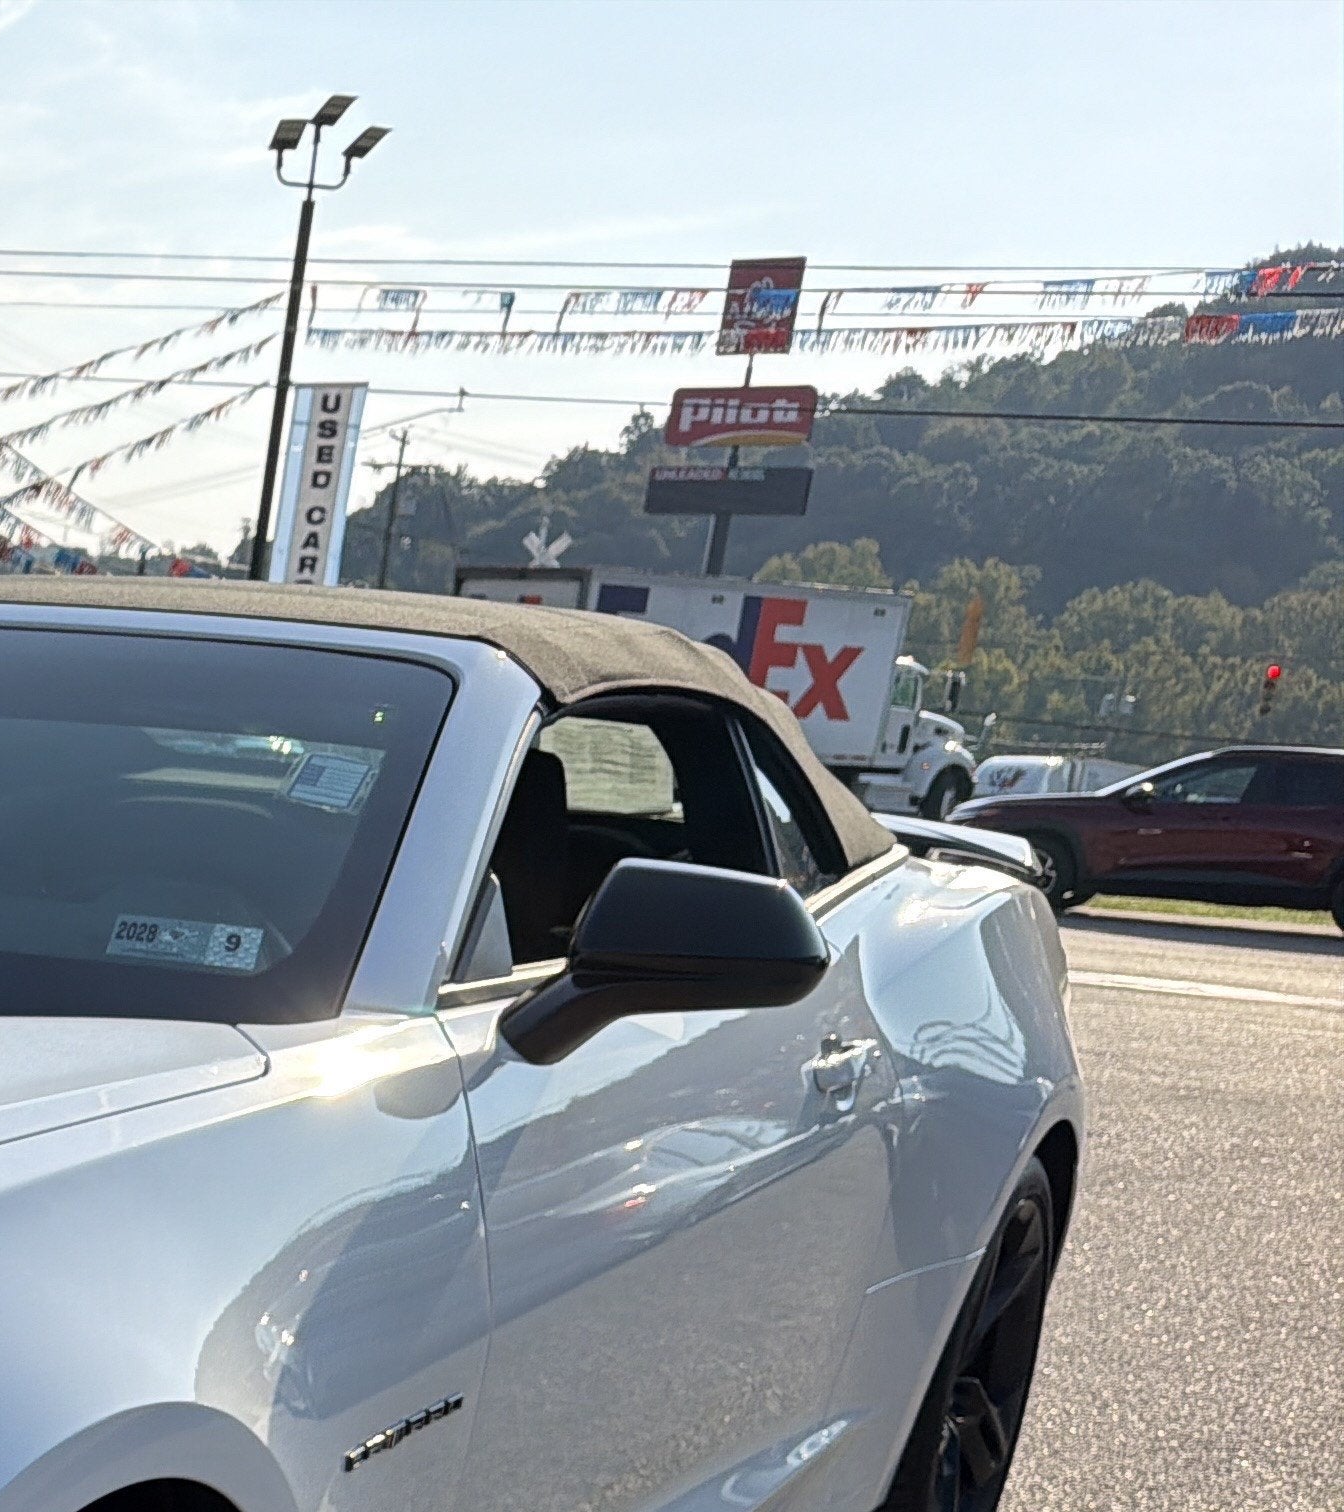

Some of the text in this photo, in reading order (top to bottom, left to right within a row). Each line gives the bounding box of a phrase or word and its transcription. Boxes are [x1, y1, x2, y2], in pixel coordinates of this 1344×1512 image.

[678, 397, 802, 432] Pilot
[295, 393, 342, 584] USED CAR
[596, 584, 865, 722] dEx
[115, 920, 242, 951] 2028 9
